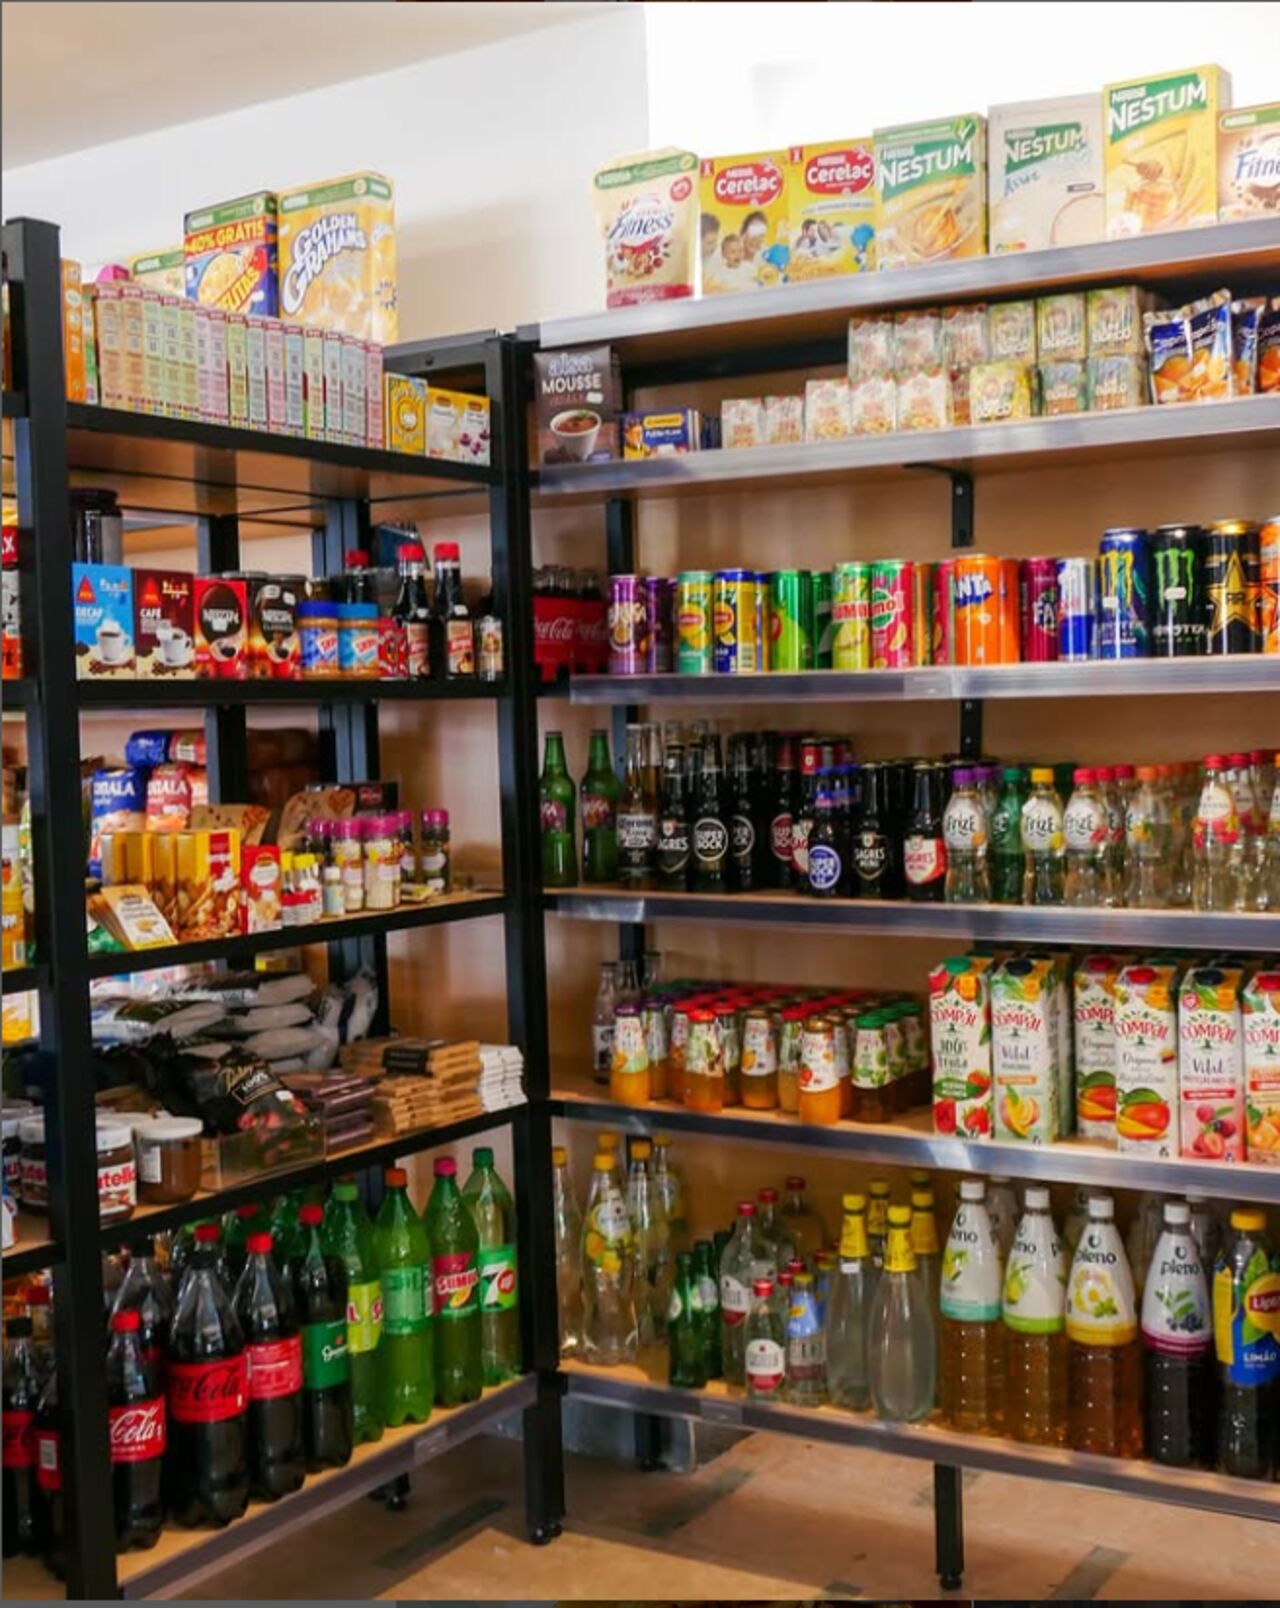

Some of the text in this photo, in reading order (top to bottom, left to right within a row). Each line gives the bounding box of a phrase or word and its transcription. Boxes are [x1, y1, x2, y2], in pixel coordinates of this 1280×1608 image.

[1109, 79, 1207, 134] NESTUM
[1003, 127, 1087, 164] NESTUM
[879, 141, 972, 190] NESTUM
[1235, 149, 1280, 181] Fitne
[215, 217, 265, 247] GRATIS
[293, 213, 356, 260] GOLDEN
[282, 228, 367, 315] GRAHAMS
[541, 373, 602, 395] MOUSSE
[1159, 1260, 1200, 1277] pleno
